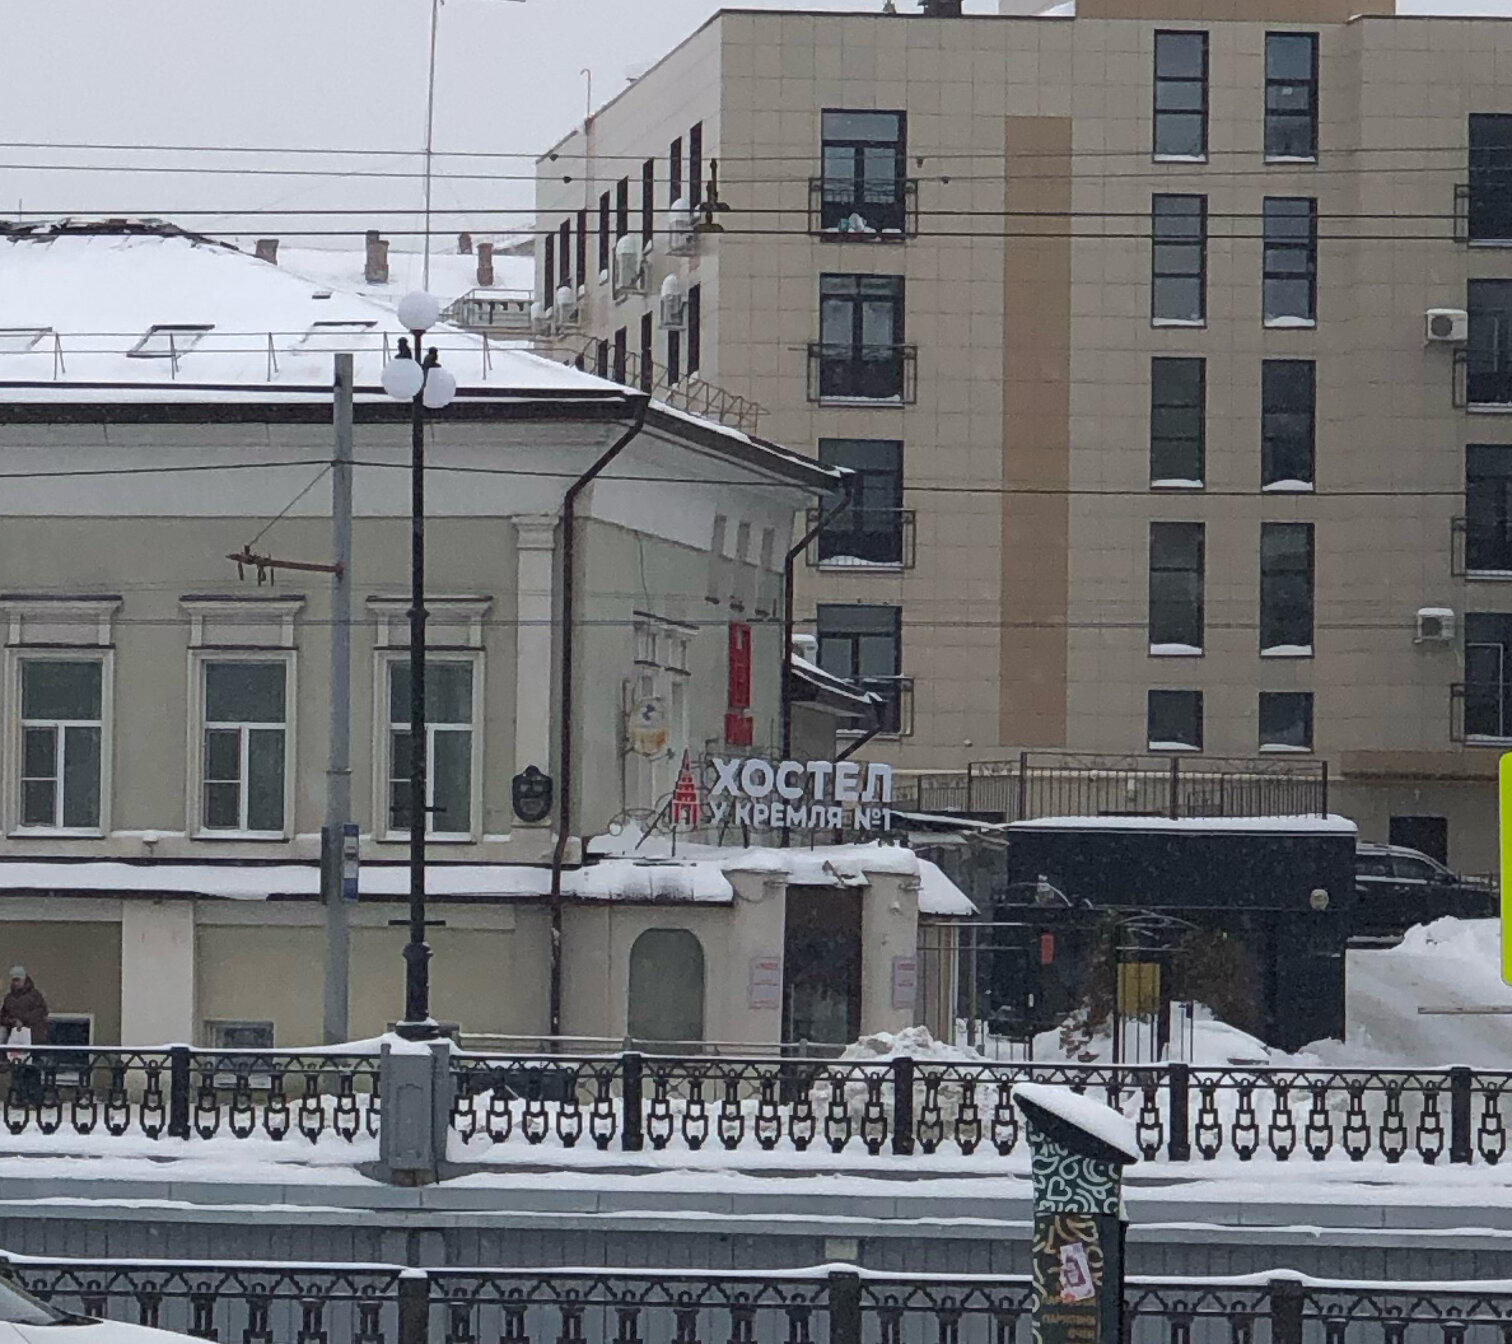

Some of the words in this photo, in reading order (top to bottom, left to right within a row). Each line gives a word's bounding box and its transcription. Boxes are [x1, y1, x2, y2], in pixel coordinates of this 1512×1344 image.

[711, 758, 893, 803] ХОСТЕЛ
[710, 801, 728, 825] У
[735, 802, 842, 829] КРЕМЛЯ
[854, 807, 892, 832] №1
